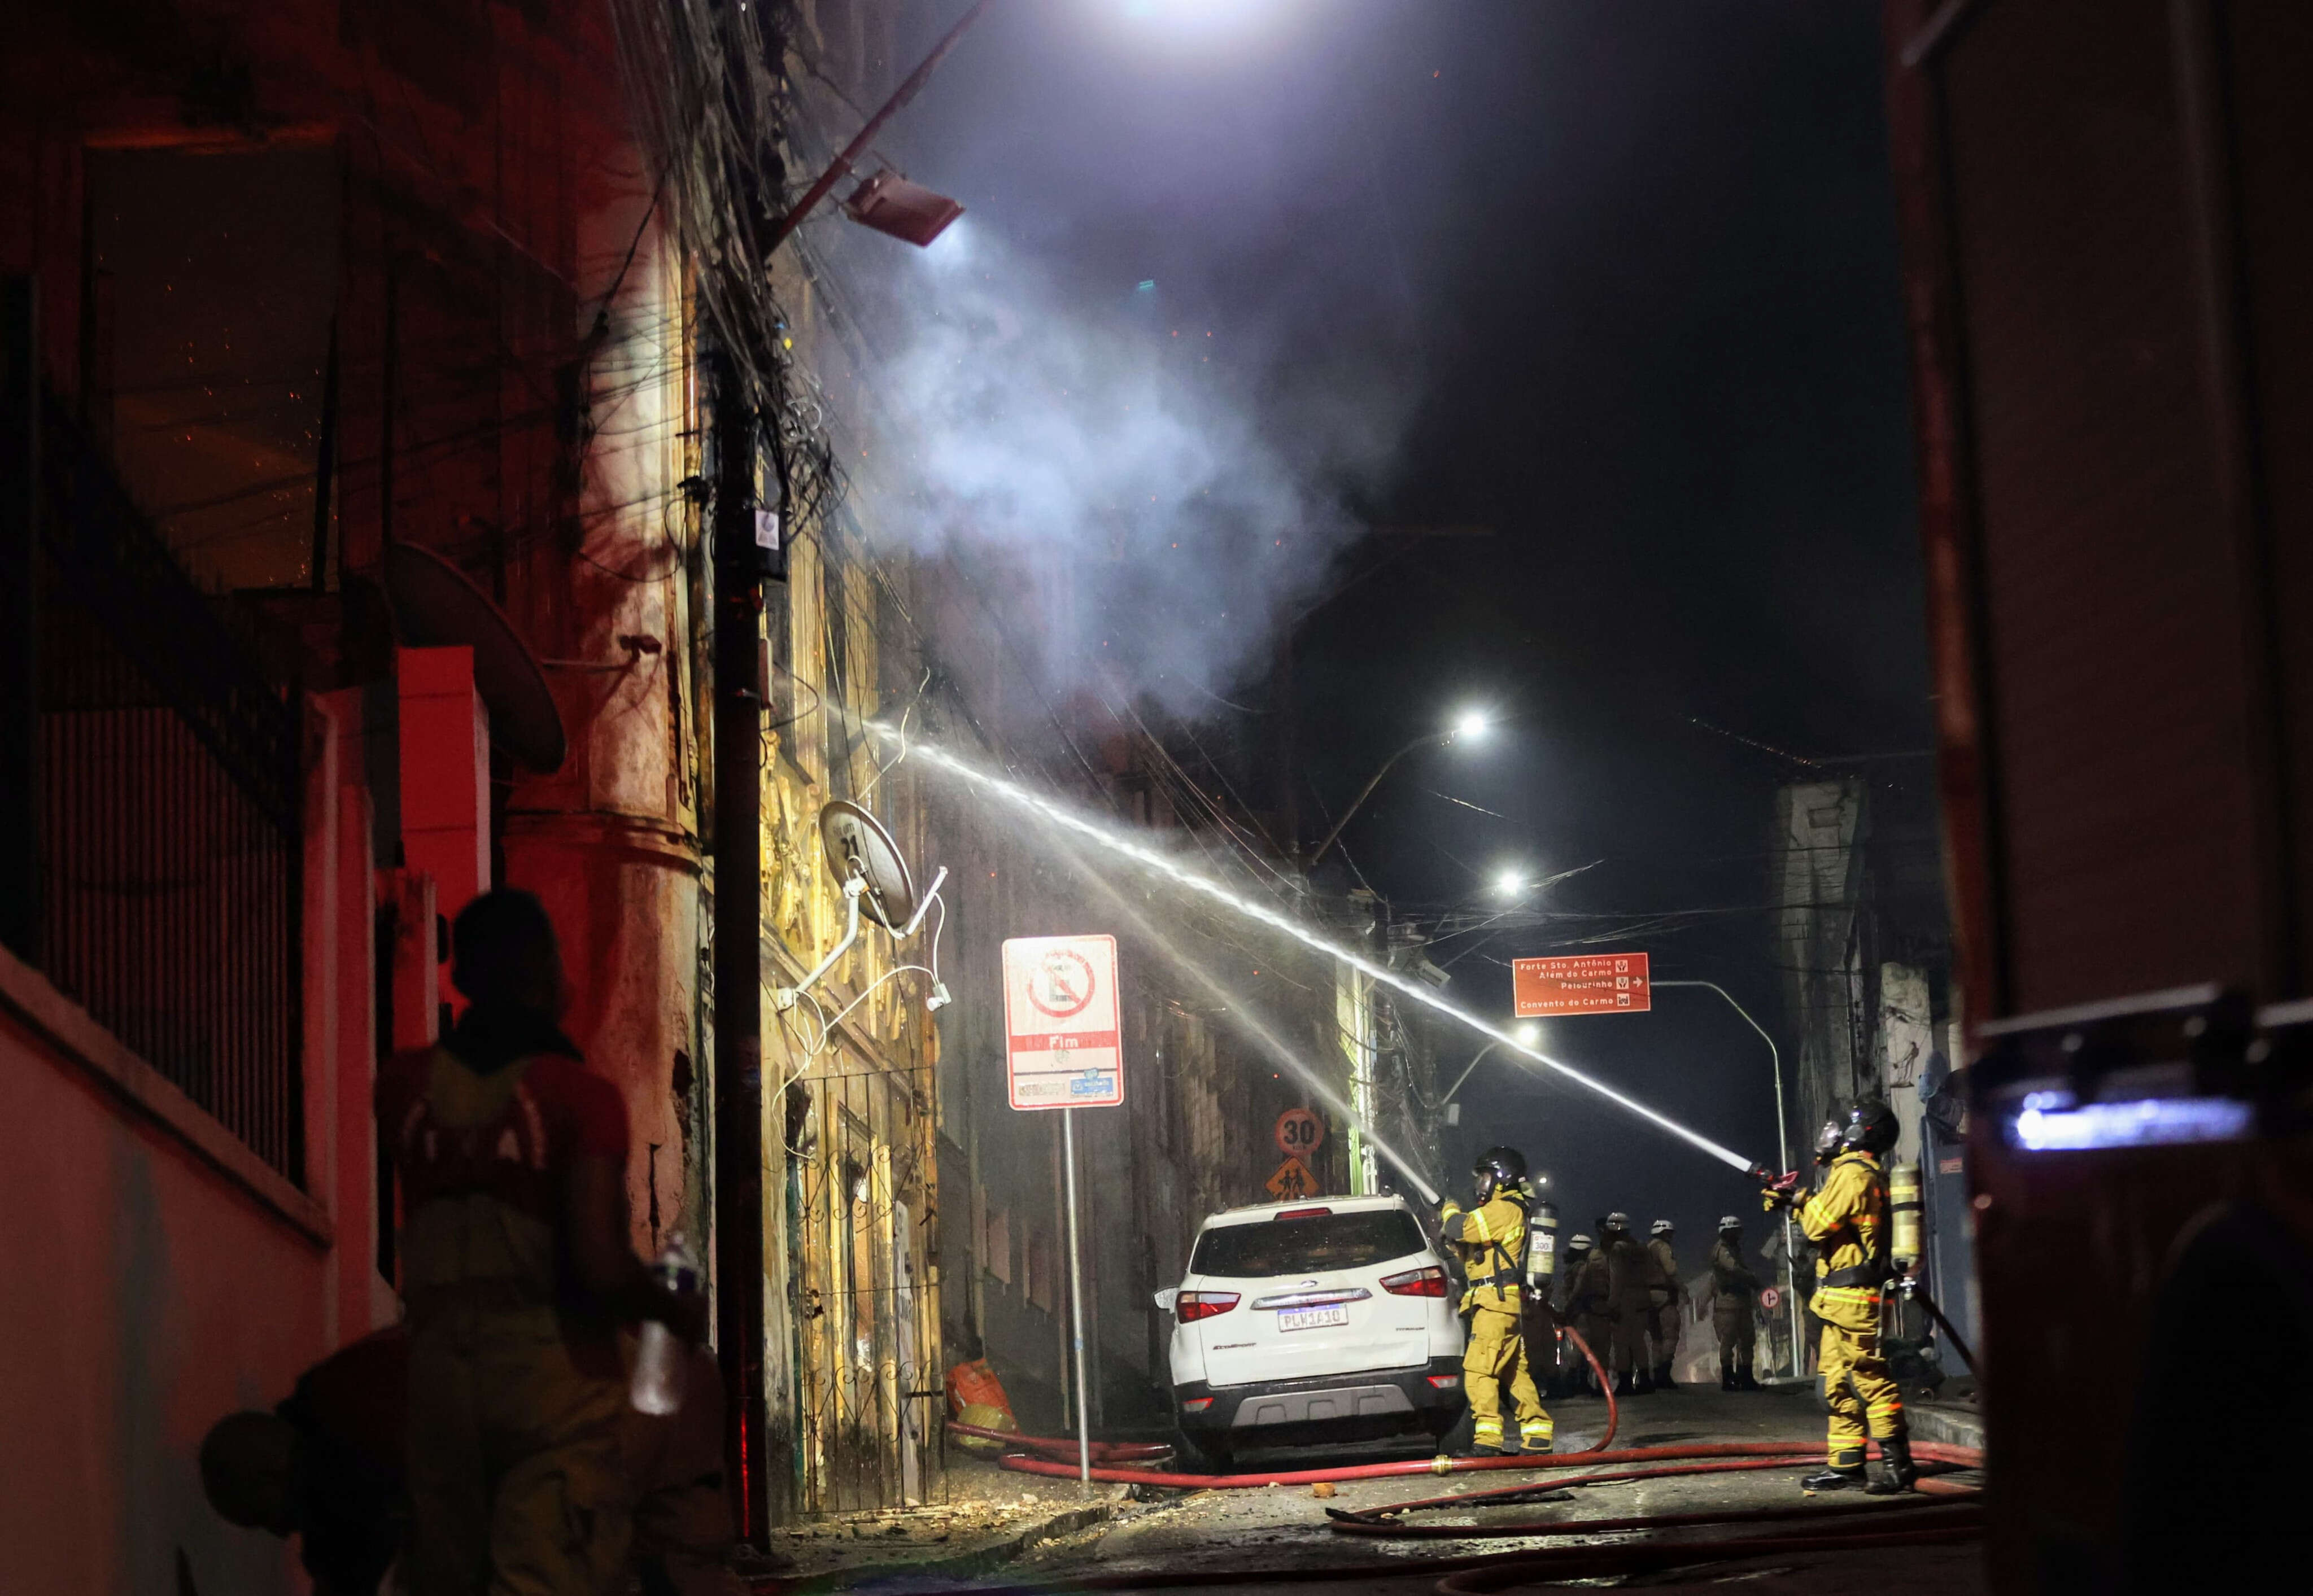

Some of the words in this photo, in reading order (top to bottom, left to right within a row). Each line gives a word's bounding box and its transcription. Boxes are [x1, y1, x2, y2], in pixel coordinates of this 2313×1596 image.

[1574, 960, 1612, 968] Antônio
[1539, 970, 1563, 979] Além
[1561, 981, 1612, 989] Pelourinho
[1049, 1035, 1078, 1049] Fim
[1284, 1120, 1315, 1144] 30
